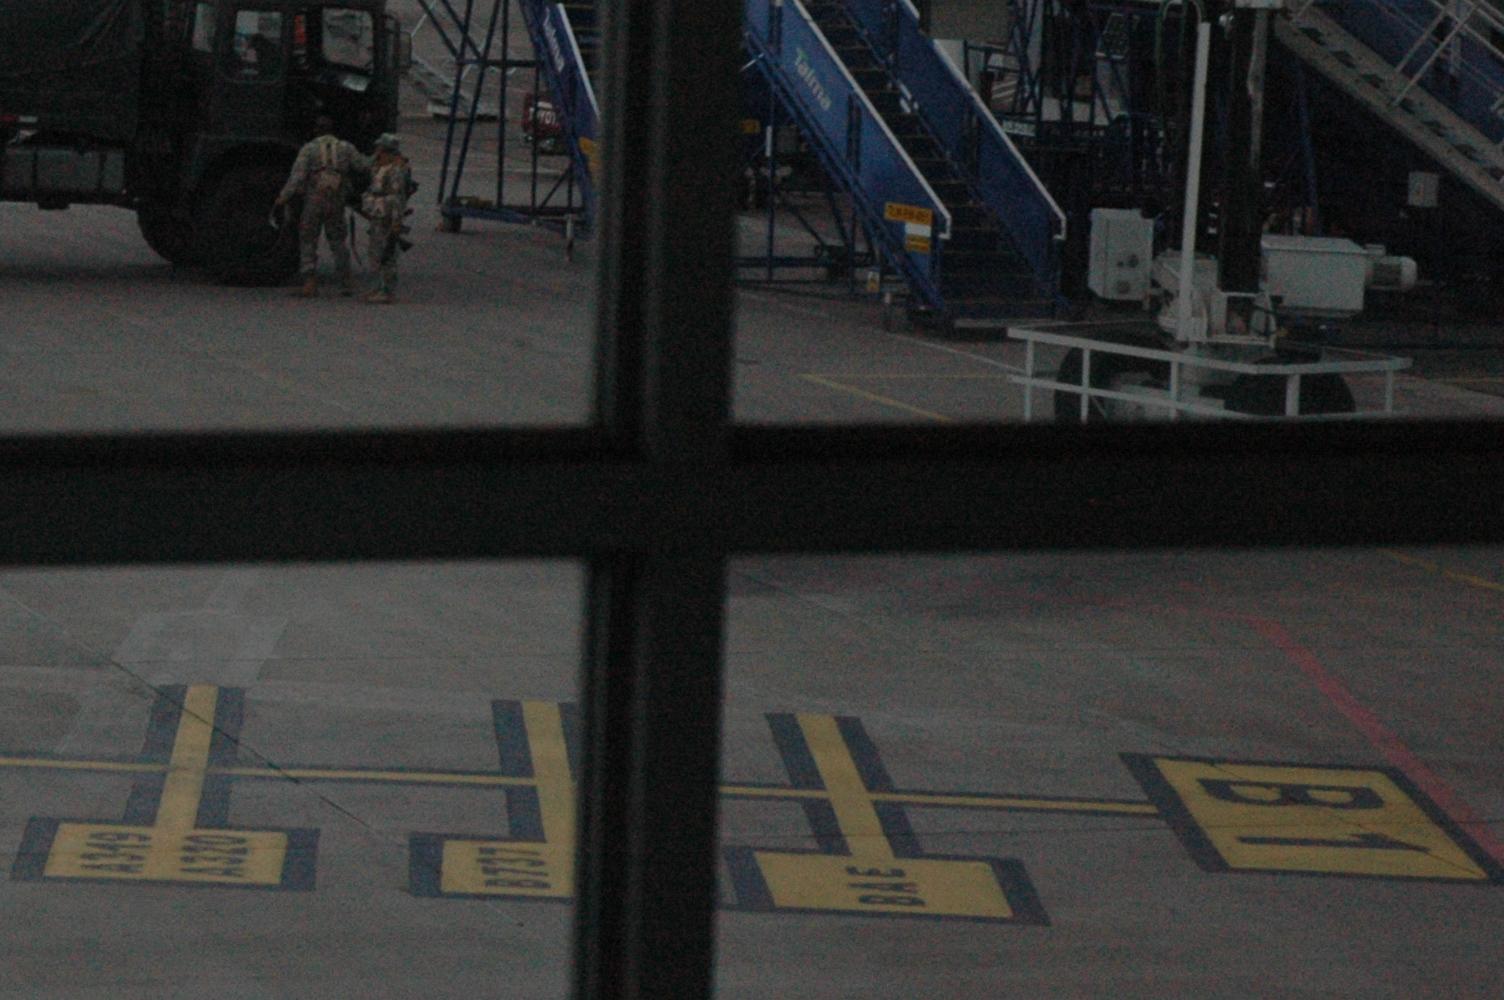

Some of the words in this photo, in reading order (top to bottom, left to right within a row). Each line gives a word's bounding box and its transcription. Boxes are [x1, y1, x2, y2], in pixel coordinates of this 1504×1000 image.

[794, 47, 832, 110] Talma
[1196, 776, 1430, 855] B1
[181, 833, 249, 878] A320
